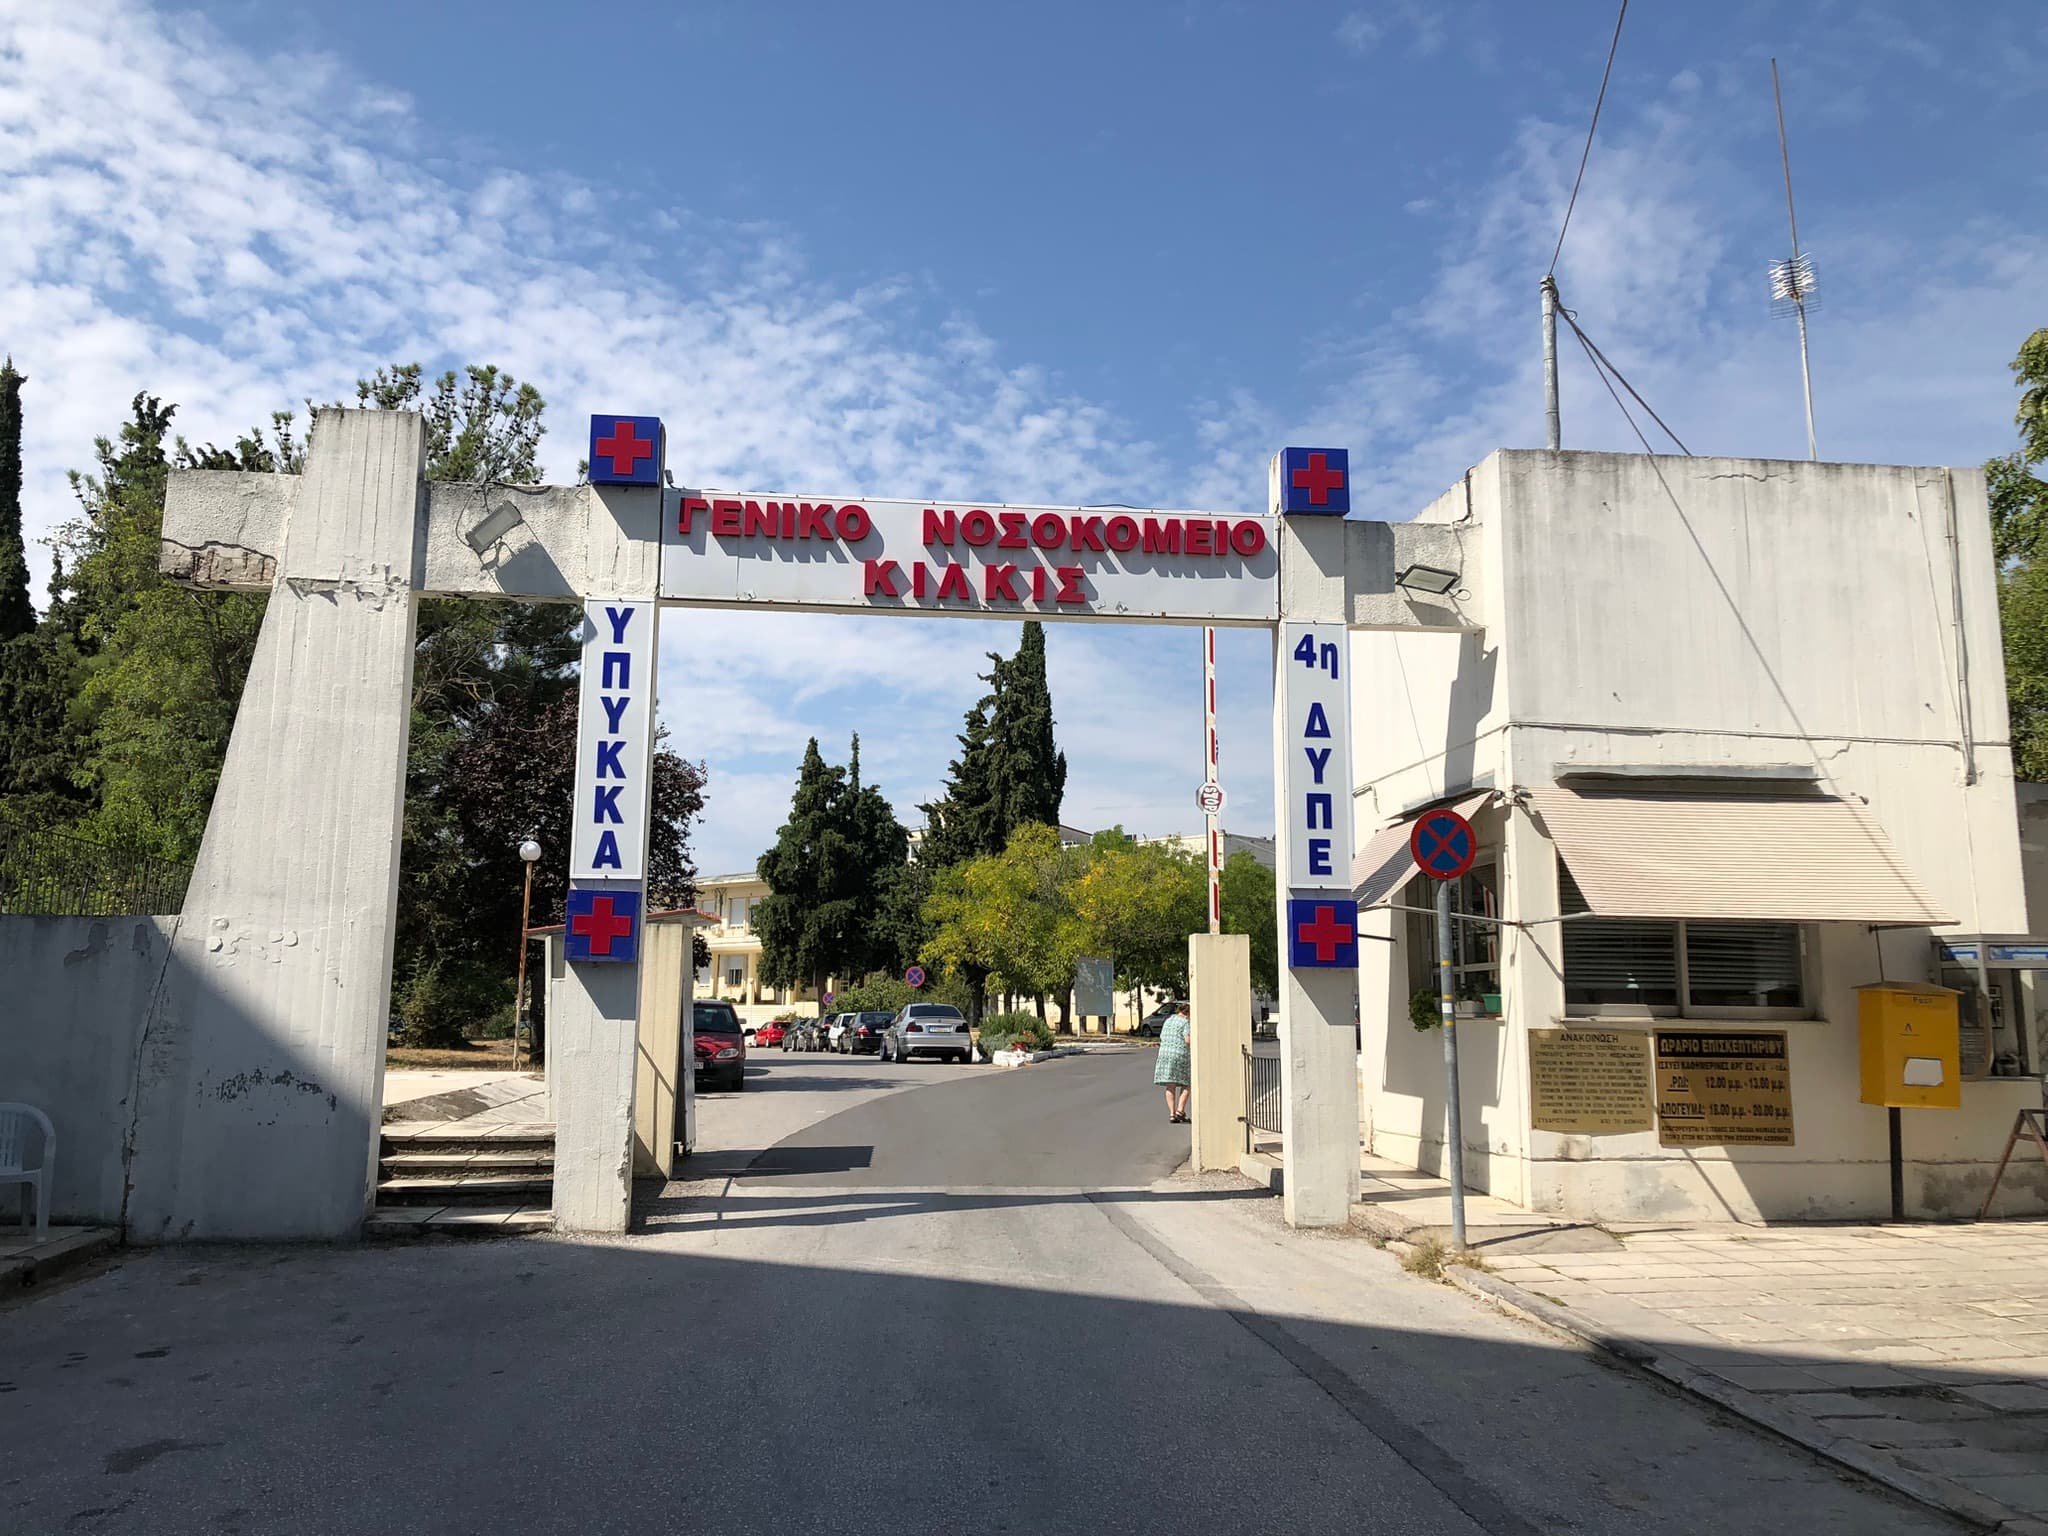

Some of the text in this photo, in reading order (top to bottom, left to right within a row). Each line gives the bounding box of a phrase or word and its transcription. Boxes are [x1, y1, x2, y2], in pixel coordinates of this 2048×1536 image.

[678, 497, 1266, 556] ΓΕΝΙΚΟ ΝΟΣΟΚΟΜΕΙΟ
[863, 558, 1085, 603] ΚΙΛΚΙΣ
[1294, 633, 1338, 680] 4η
[592, 607, 635, 869] ΥΠΥΚΚΑ
[1304, 702, 1333, 876] ΔΥΠΕ
[1560, 1033, 1619, 1043] ΑΝΑΚΟΙΝΩΣΗ
[1661, 1038, 1785, 1054] ΩΡΑΡΙΟ ΕΠΙΣΚΕΠΤΗΡΙΟΥ
